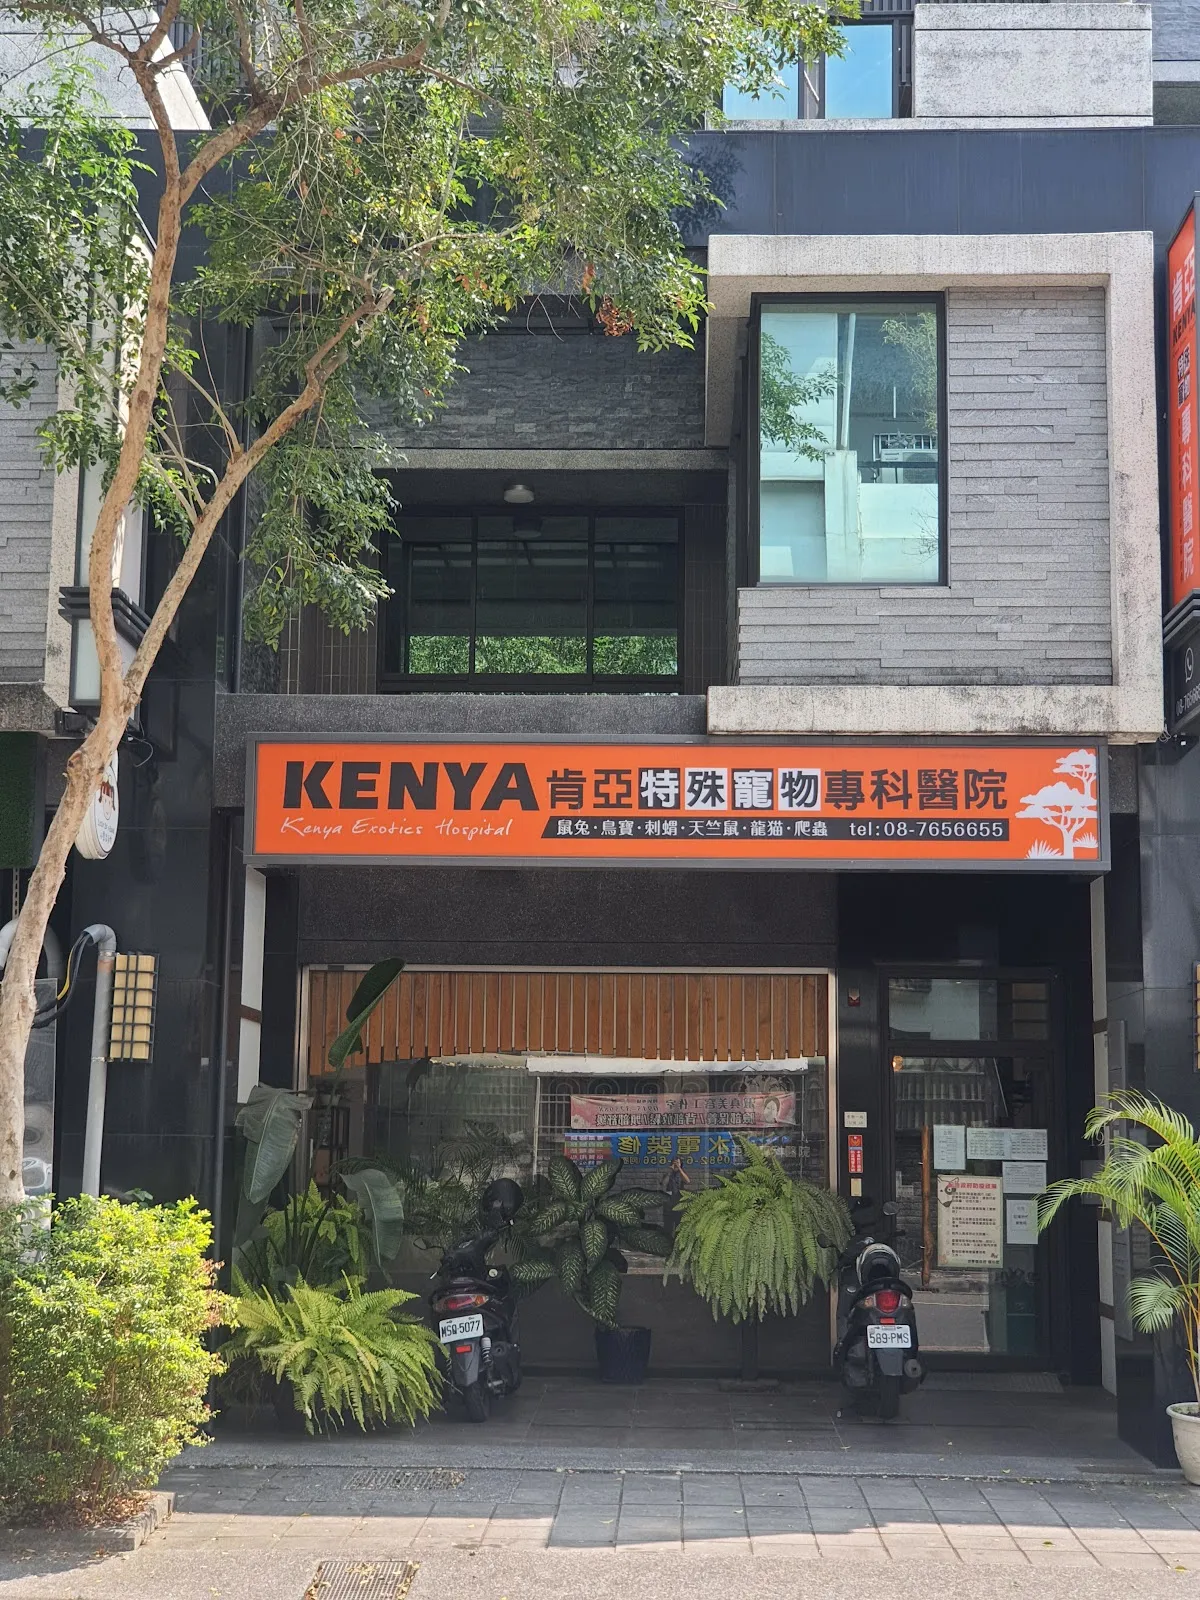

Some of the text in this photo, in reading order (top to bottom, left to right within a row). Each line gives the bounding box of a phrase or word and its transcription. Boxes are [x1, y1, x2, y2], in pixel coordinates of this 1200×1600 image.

[283, 761, 540, 811] KENYA
[546, 767, 1008, 810] 肯亞特殊寵物專科醫院
[280, 817, 513, 841] Kenya Exotics Hospital
[849, 820, 1004, 838] tel:08-7656655
